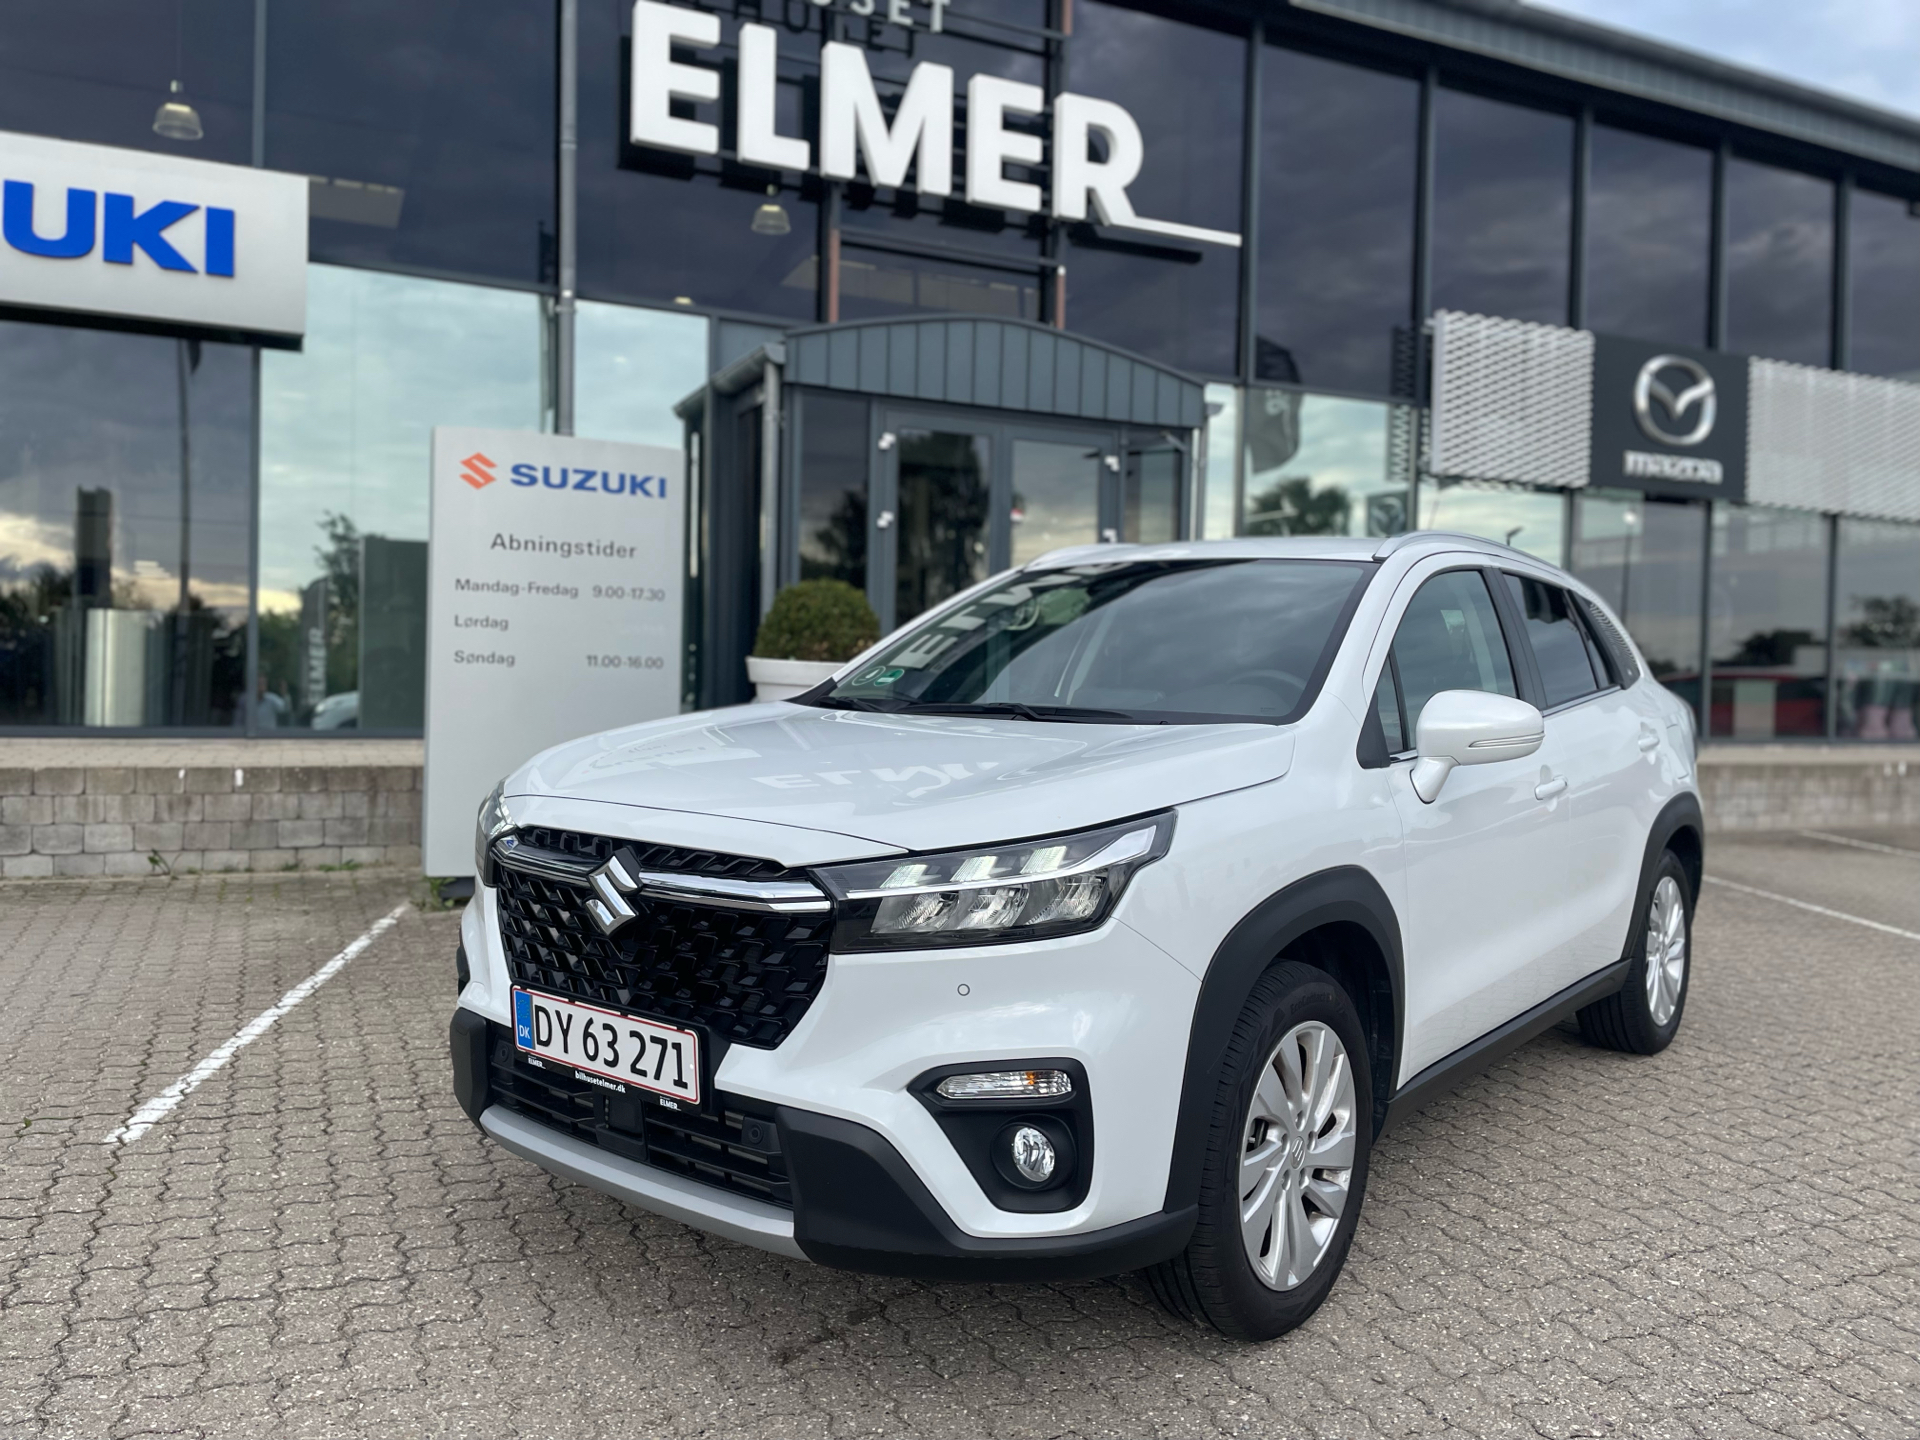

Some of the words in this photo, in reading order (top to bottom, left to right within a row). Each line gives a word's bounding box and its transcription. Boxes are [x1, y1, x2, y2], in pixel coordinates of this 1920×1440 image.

[630, 0, 1242, 247] ELMER
[2, 178, 235, 278] UKI
[510, 462, 668, 499] SUZUKI
[454, 614, 509, 632] Lørdag
[453, 649, 516, 668] Søndag
[518, 1024, 531, 1039] DK
[534, 1004, 573, 1054] DY
[582, 1017, 620, 1068] 63
[629, 1030, 689, 1090] 271
[528, 1056, 546, 1069] ELMER
[574, 1070, 626, 1094] bilhusetelmer.dk
[660, 1098, 681, 1112] ELMER
